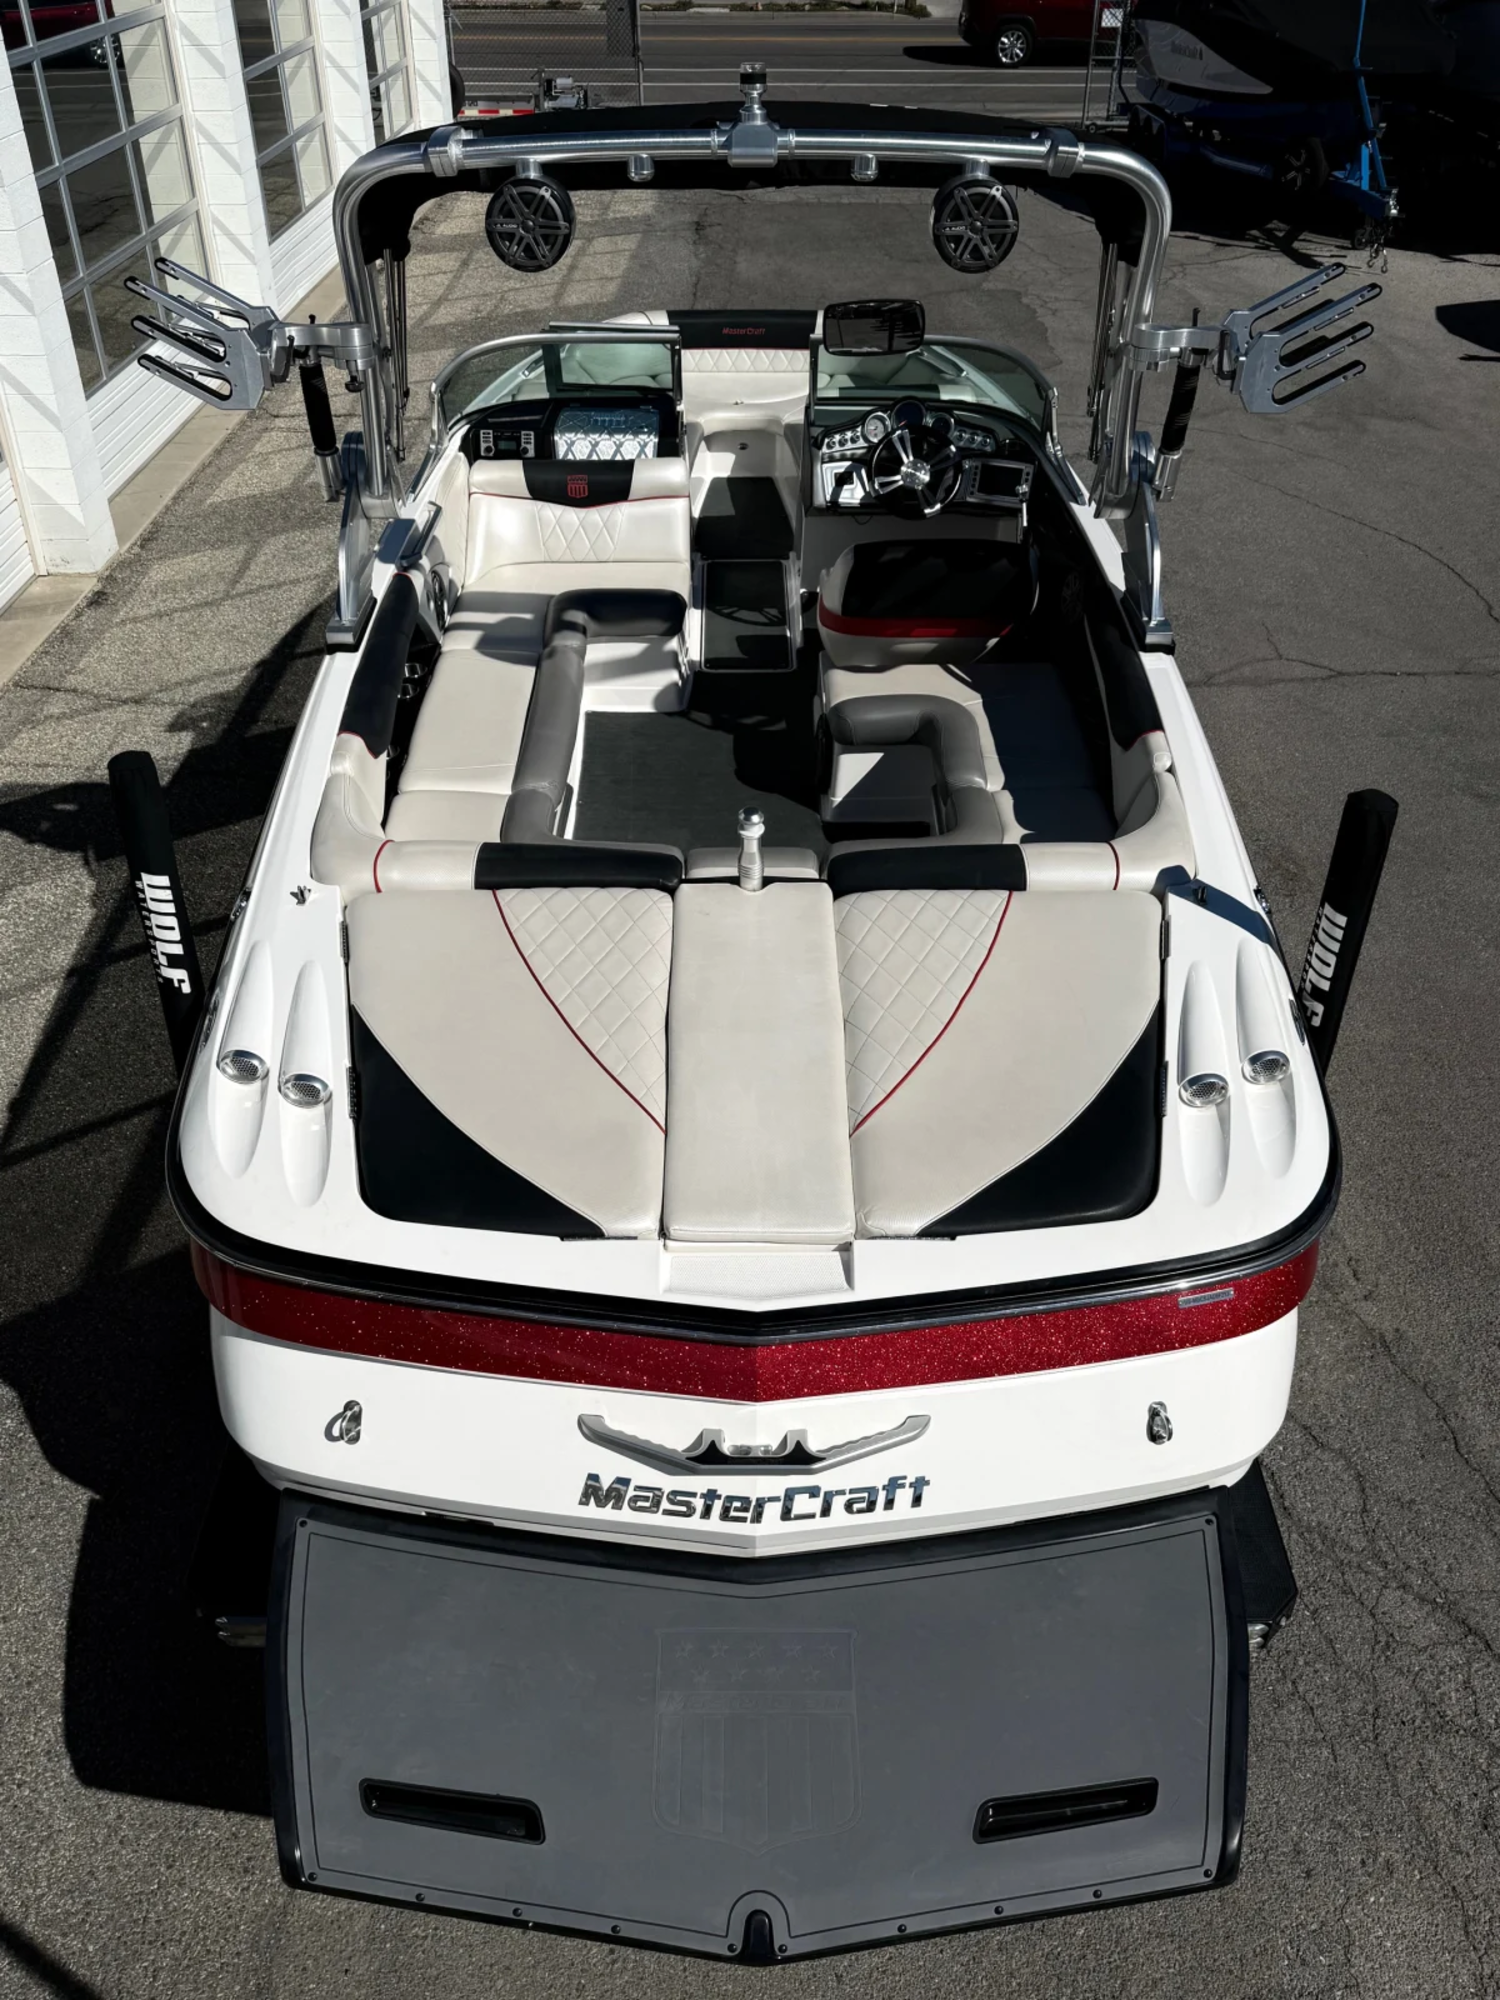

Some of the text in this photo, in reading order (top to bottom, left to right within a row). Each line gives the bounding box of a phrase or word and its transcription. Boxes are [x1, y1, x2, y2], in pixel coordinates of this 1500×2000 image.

[135, 880, 164, 983] WATERSPORTS
[140, 872, 191, 994] WOLF
[1302, 901, 1348, 1027] WOLF
[578, 1473, 931, 1525] MasterCraft
